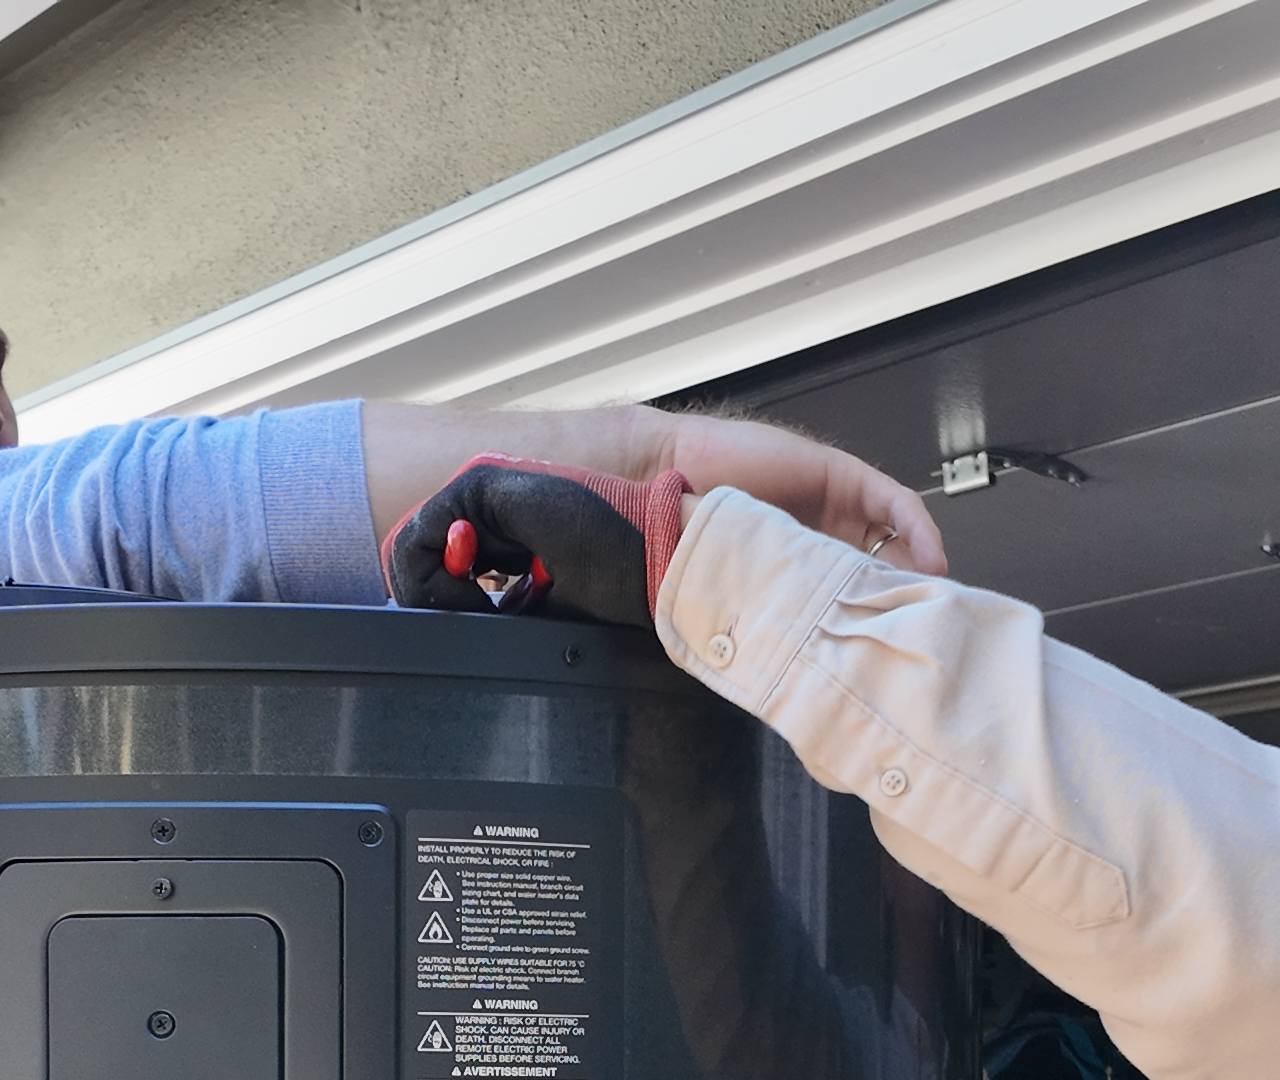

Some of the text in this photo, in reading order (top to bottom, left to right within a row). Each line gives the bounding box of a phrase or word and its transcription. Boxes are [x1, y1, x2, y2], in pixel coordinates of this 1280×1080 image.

[485, 826, 539, 838] WARNING
[418, 845, 576, 859] INSTALL PROPERLY TO REDUCE THE RISK OF
[485, 999, 538, 1010] WARNING
[455, 1017, 497, 1025] WARNING
[504, 1017, 523, 1025] RISK
[539, 1018, 578, 1026] ELECTRIC
[455, 1026, 488, 1034] SHOCK.
[511, 1027, 539, 1035] CAUSE
[541, 1027, 571, 1035] INJURY
[572, 1028, 585, 1036] OR
[489, 1036, 543, 1044] DISCONNECT
[545, 1036, 560, 1044] ALL
[456, 1045, 567, 1054] REMOTE ELECTRIC POWER
[455, 1055, 581, 1064] SUPPLIES BEFORE SERVICING.
[464, 1066, 557, 1077] AVERTISSEMENT
